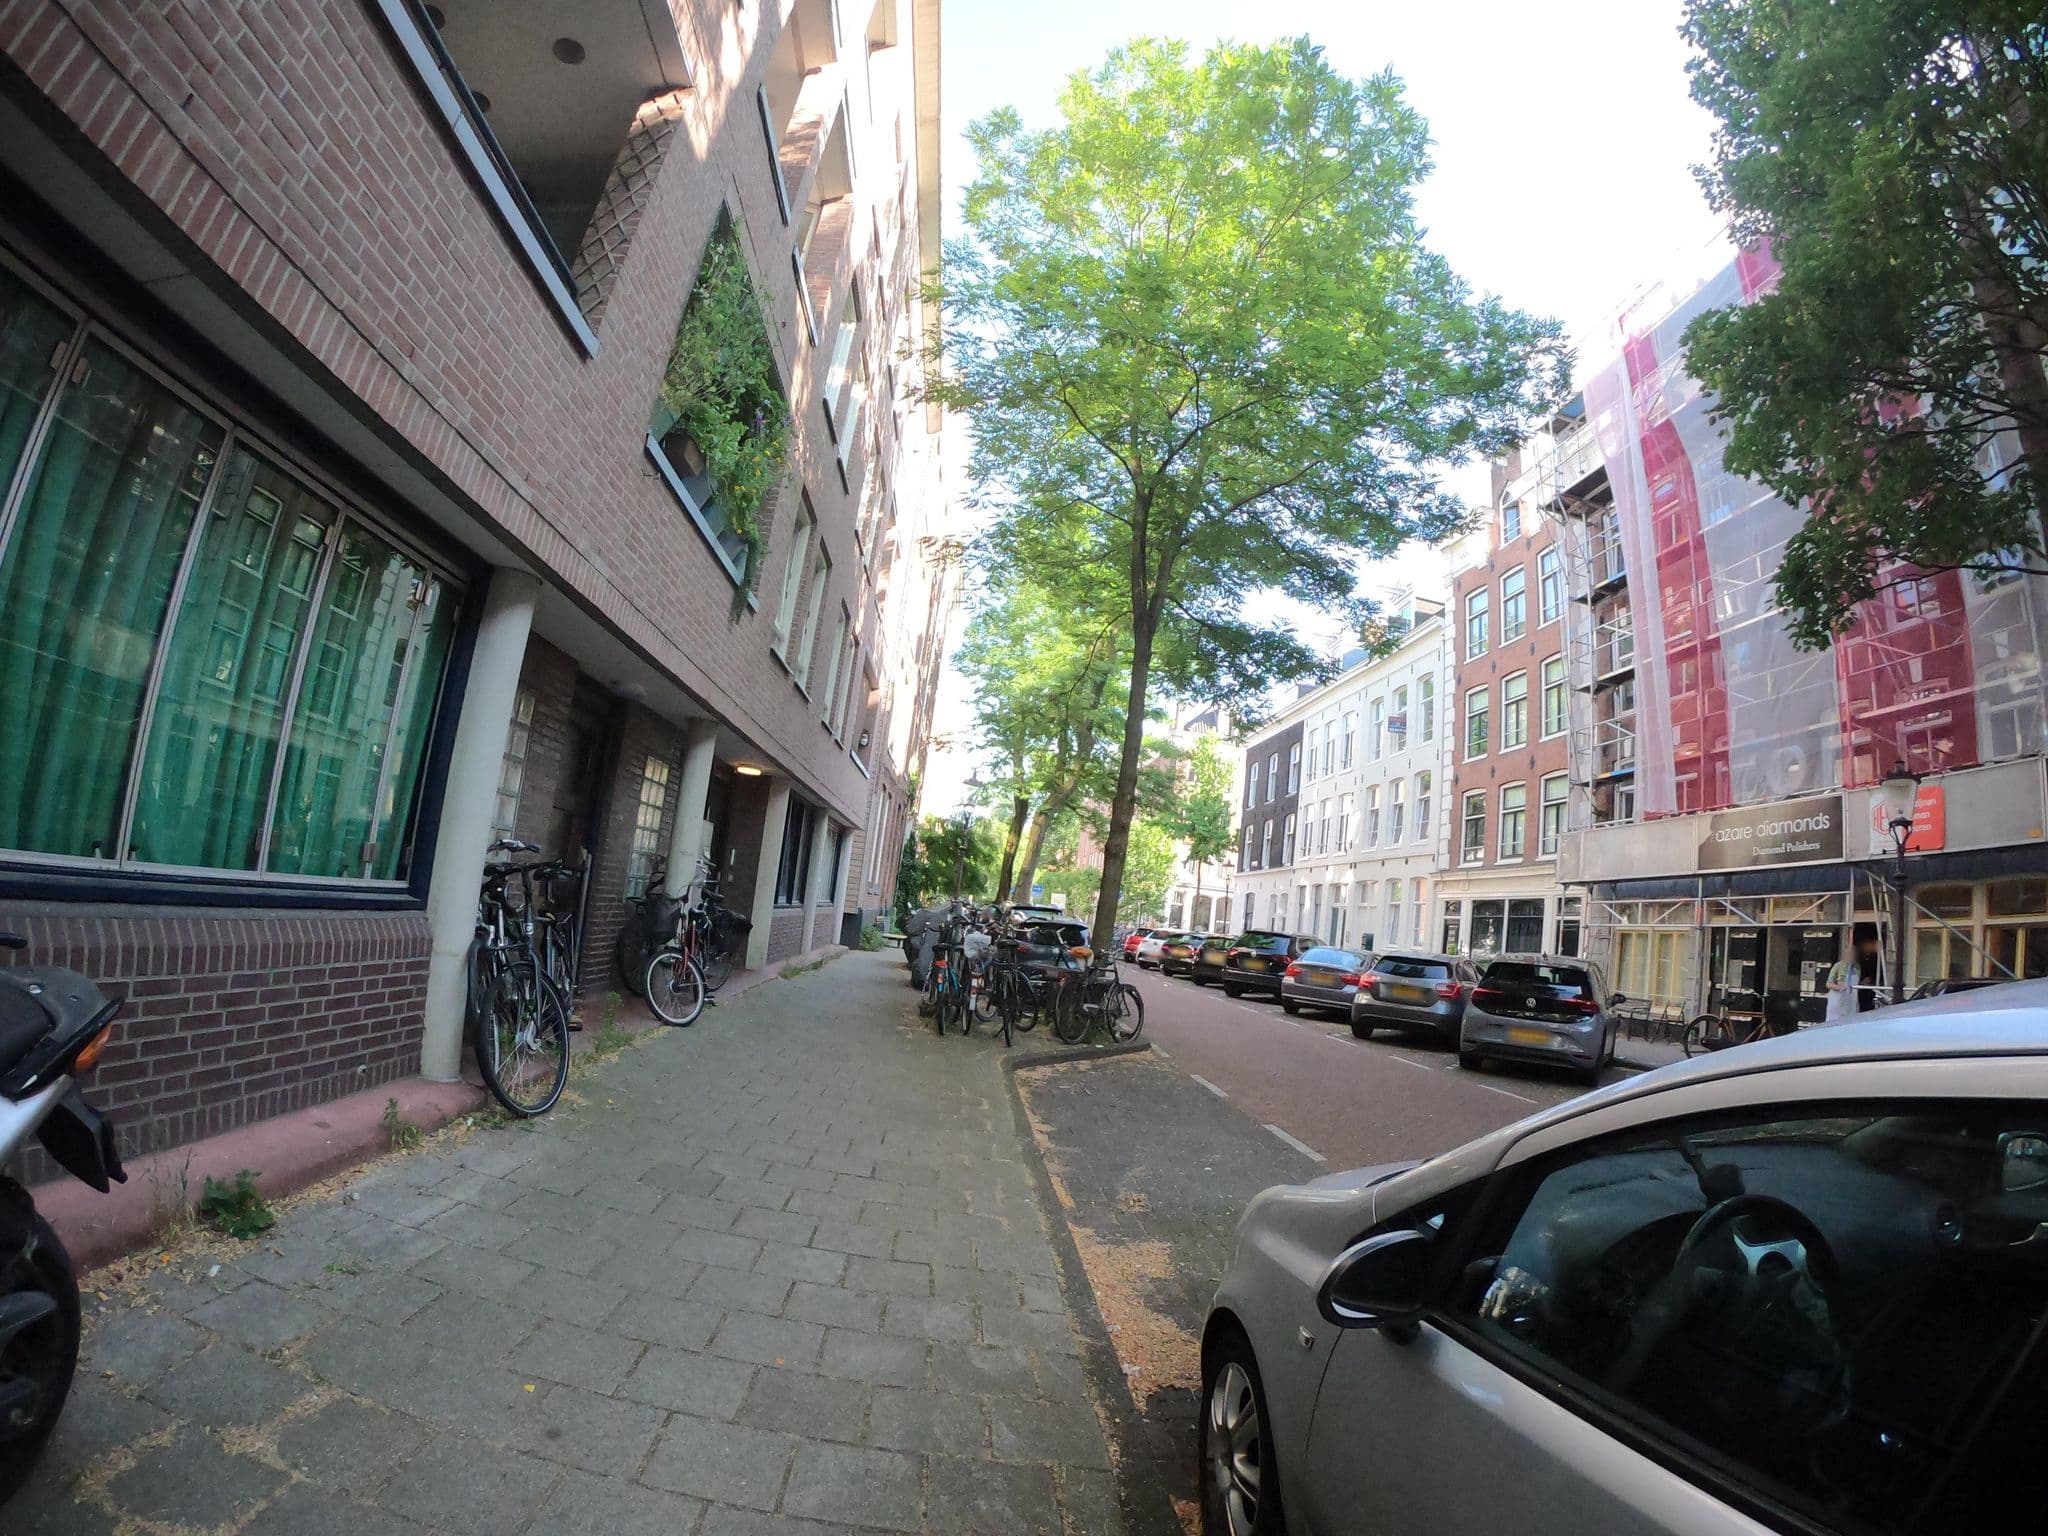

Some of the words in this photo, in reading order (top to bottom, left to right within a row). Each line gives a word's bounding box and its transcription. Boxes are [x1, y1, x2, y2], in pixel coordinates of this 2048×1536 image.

[1714, 825, 1752, 842] azare
[1756, 812, 1830, 837] diamonds
[1752, 842, 1786, 856] Diamond
[1786, 839, 1821, 853] Polishers
